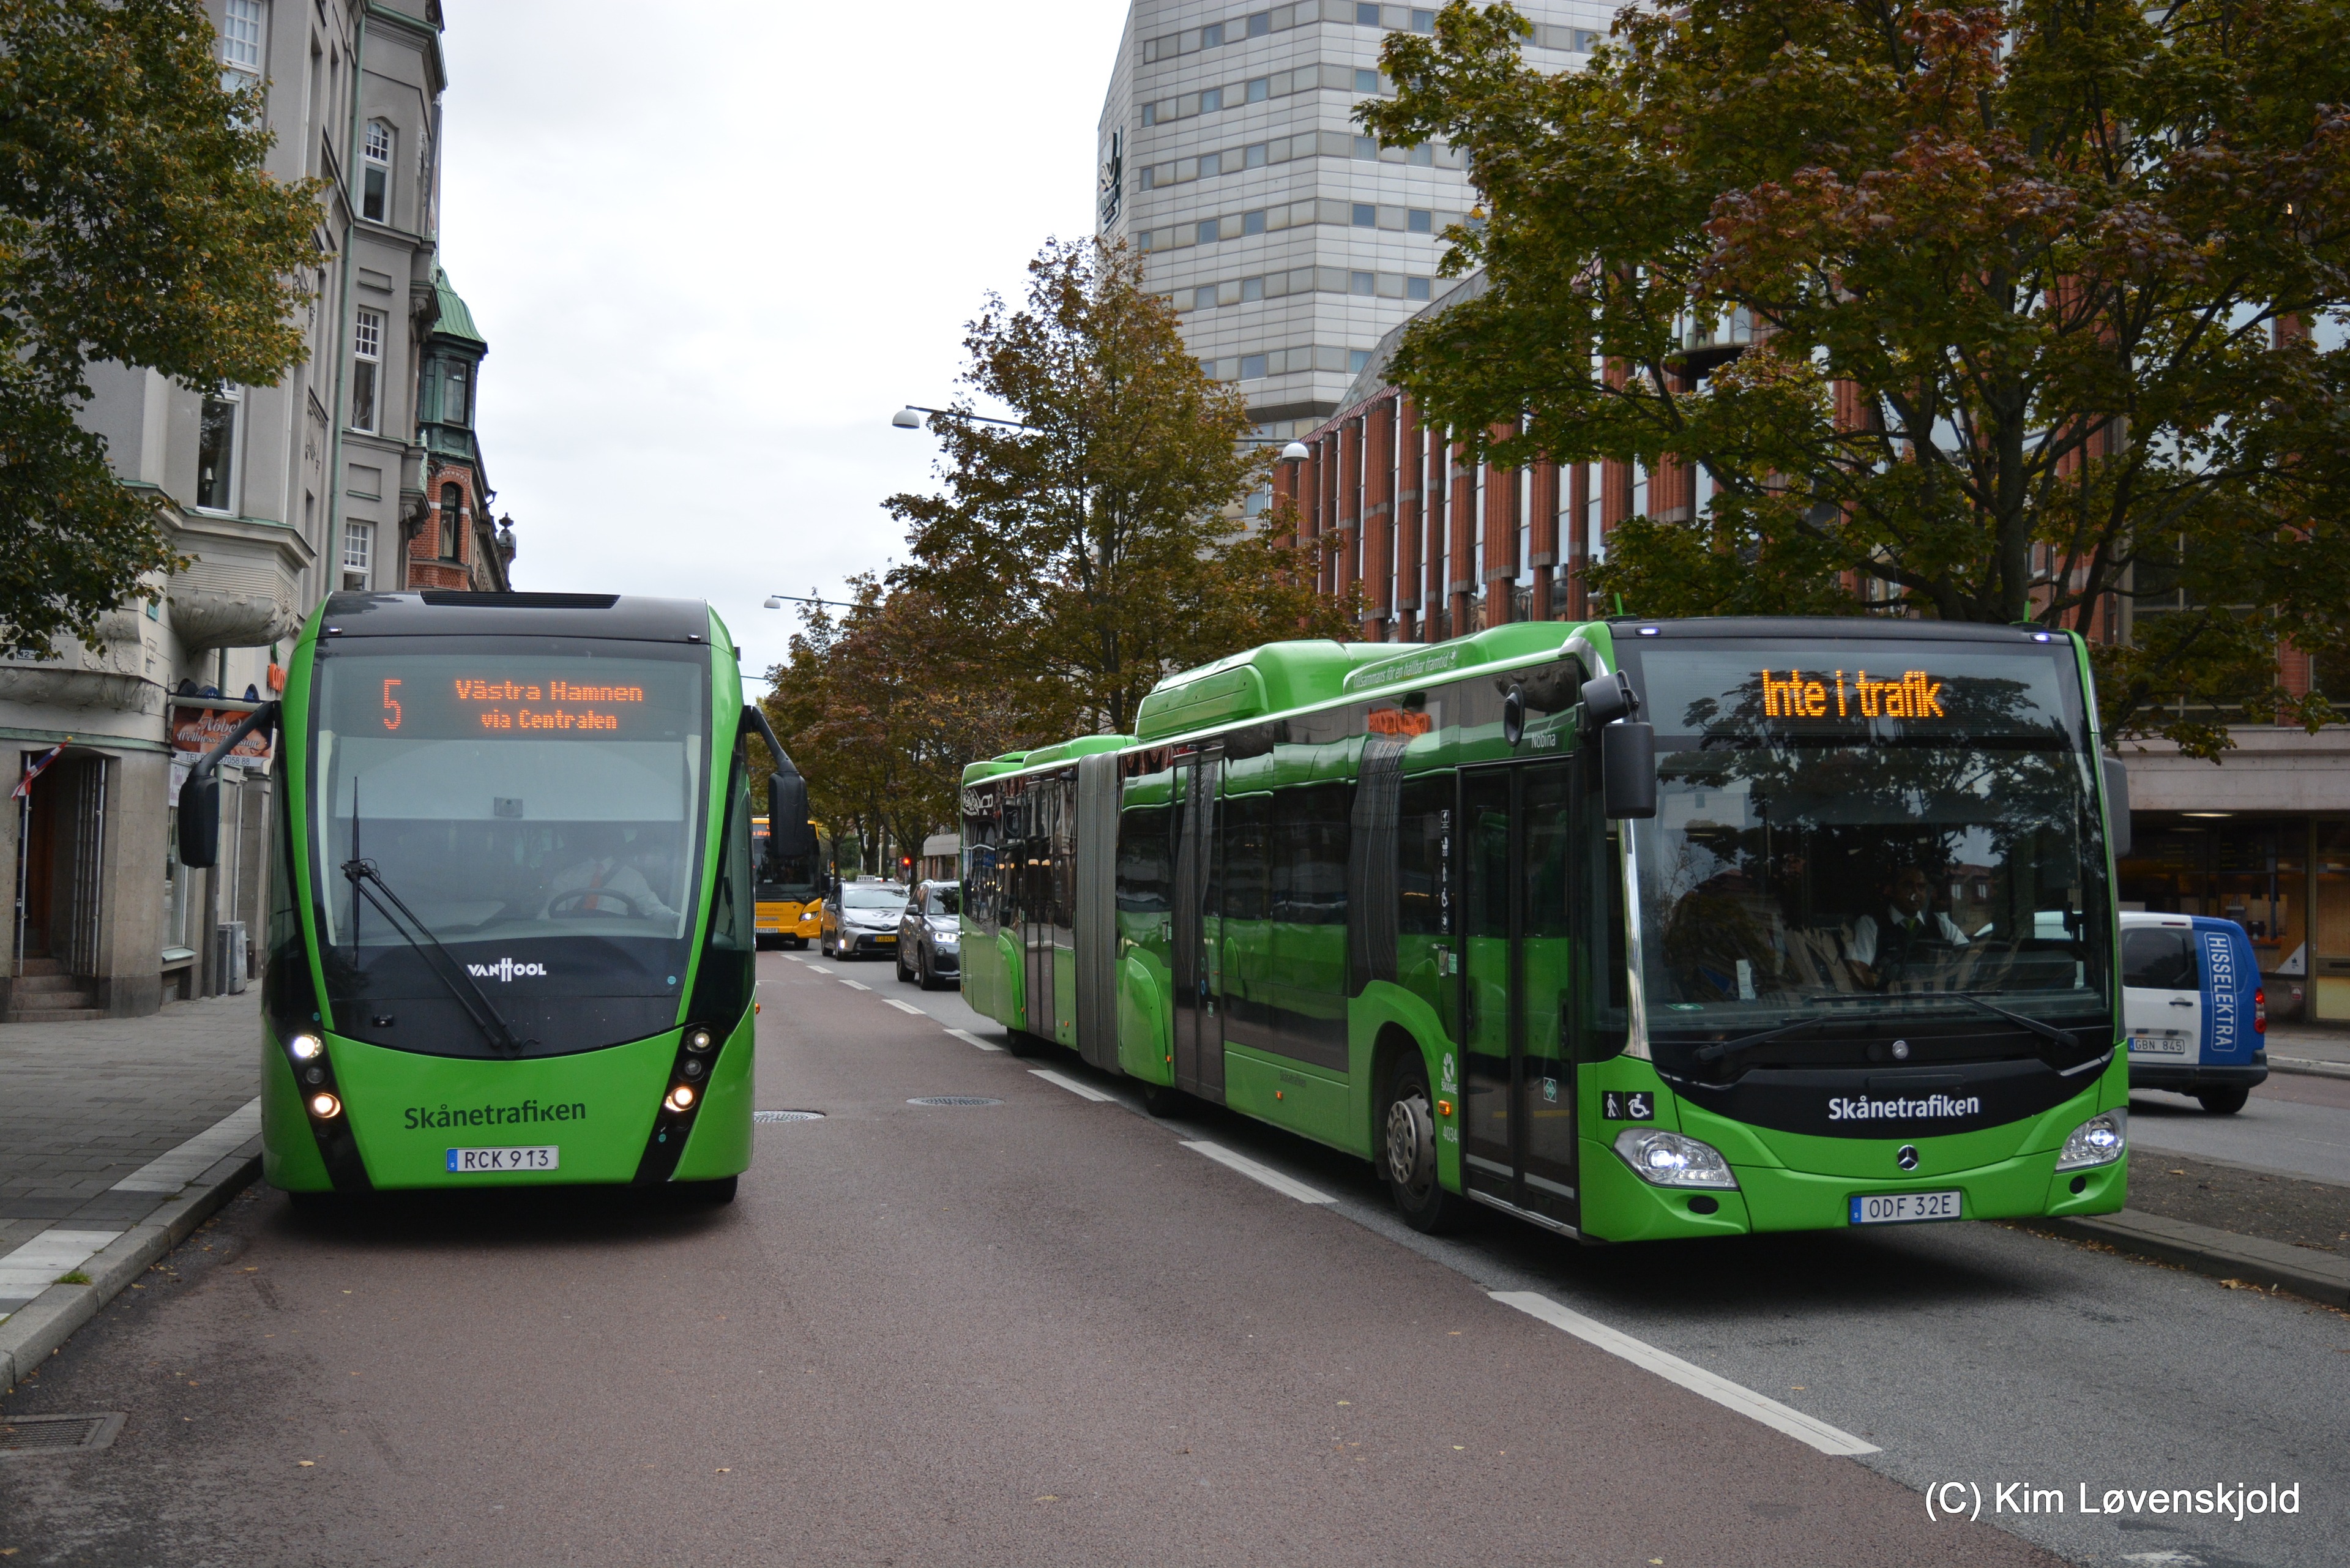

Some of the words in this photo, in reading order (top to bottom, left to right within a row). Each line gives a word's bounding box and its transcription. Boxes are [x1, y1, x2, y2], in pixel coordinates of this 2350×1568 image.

[1353, 671, 1385, 689] Tillsammans
[1386, 665, 1395, 681] för
[1395, 668, 1403, 679] en
[1403, 659, 1425, 676] hållbar
[1425, 652, 1449, 672] framtid
[455, 680, 541, 700] Västra
[550, 681, 643, 701] Hamnen
[1762, 670, 1827, 717] Inte
[1836, 670, 1846, 717] i
[1855, 671, 1944, 717] trafik
[383, 679, 401, 730] 5
[481, 709, 511, 728] via
[519, 709, 617, 730] Centralen
[177, 731, 216, 744] Wellness
[1531, 731, 1556, 749] Nobina
[2209, 937, 2234, 1046] HISSELEKTRA
[2135, 1040, 2155, 1050] GBN
[2163, 1041, 2182, 1051] 845
[404, 1100, 586, 1130] Skånetrafiken
[1828, 1094, 1979, 1119] Skånetrafiken
[1442, 1125, 1458, 1143] 4034
[465, 1151, 502, 1168] RCK
[510, 1149, 548, 1167] 913
[1869, 1197, 1907, 1218] ODF
[1915, 1195, 1951, 1215] 32E
